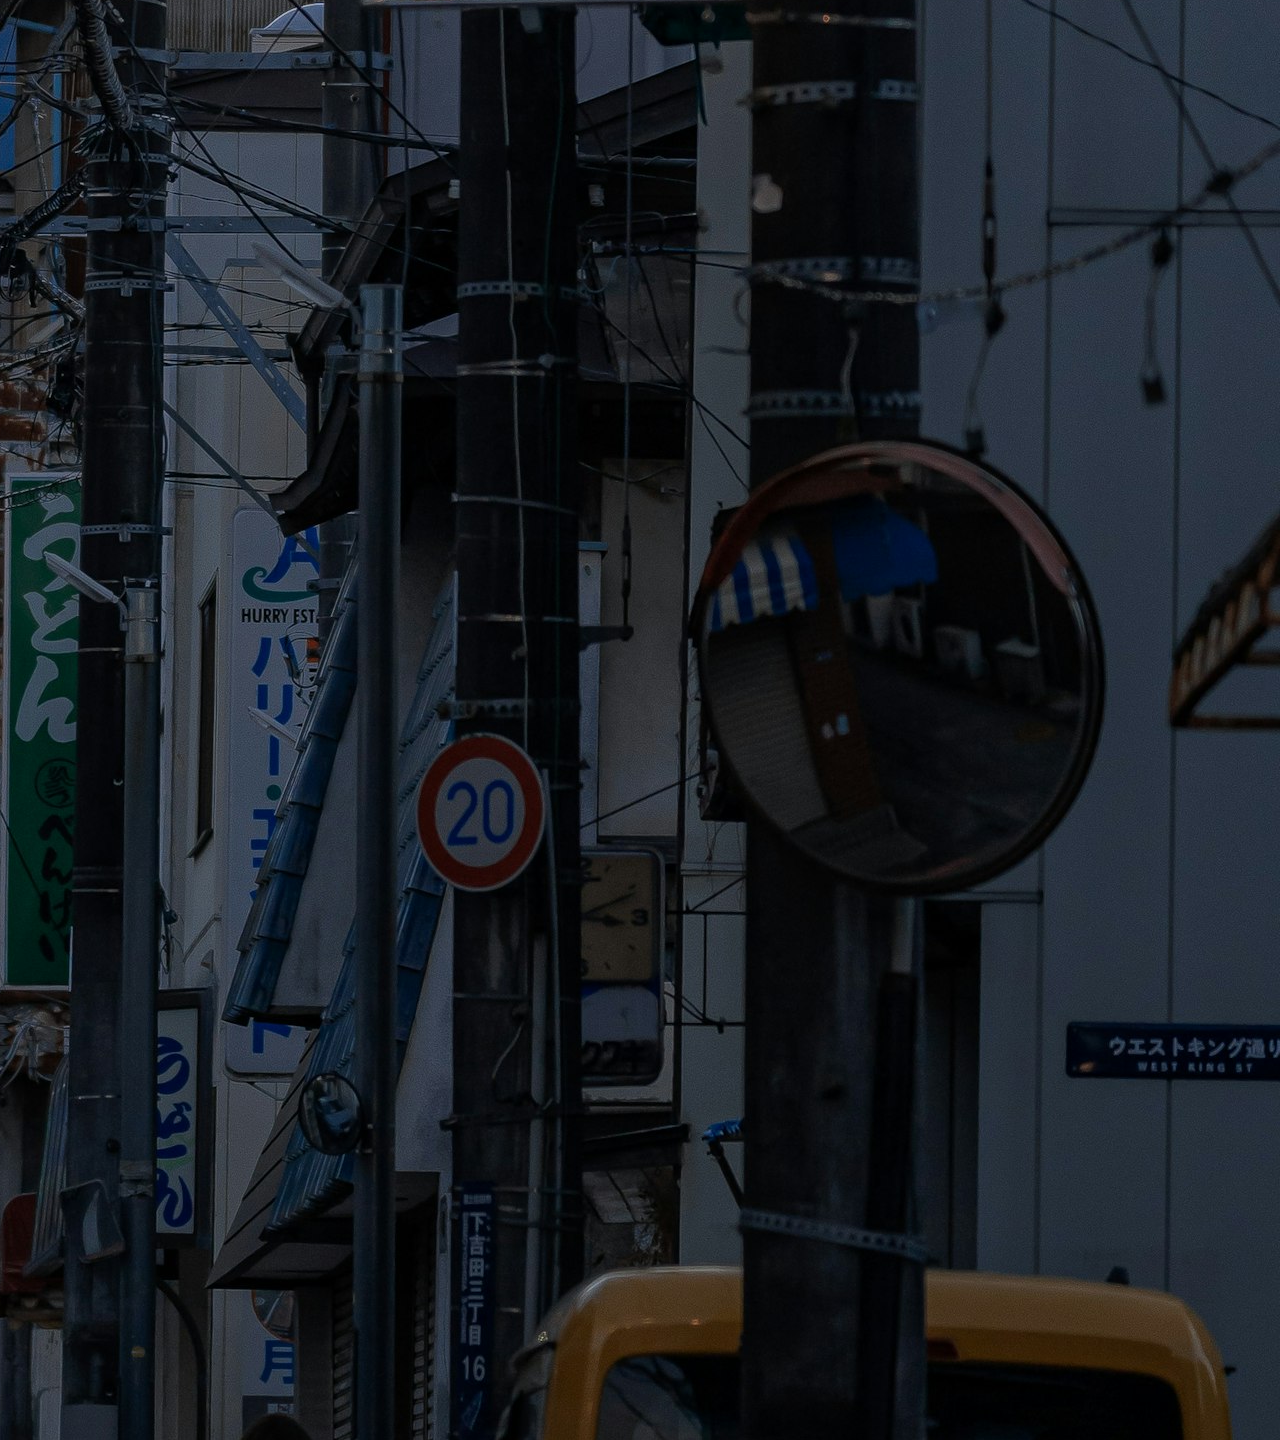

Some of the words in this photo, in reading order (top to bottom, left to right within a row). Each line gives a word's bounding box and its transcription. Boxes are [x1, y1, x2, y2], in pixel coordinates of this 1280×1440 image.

[15, 494, 79, 744] うどん
[242, 608, 289, 623] HURRY
[293, 608, 320, 623] EST
[447, 780, 514, 845] 20
[1137, 1061, 1179, 1073] WEST
[1188, 1062, 1227, 1073] KING
[1235, 1063, 1254, 1073] ST
[157, 1036, 193, 1228] うどん
[468, 1212, 486, 1346] 下吉田三丁目
[462, 1355, 486, 1382] 16
